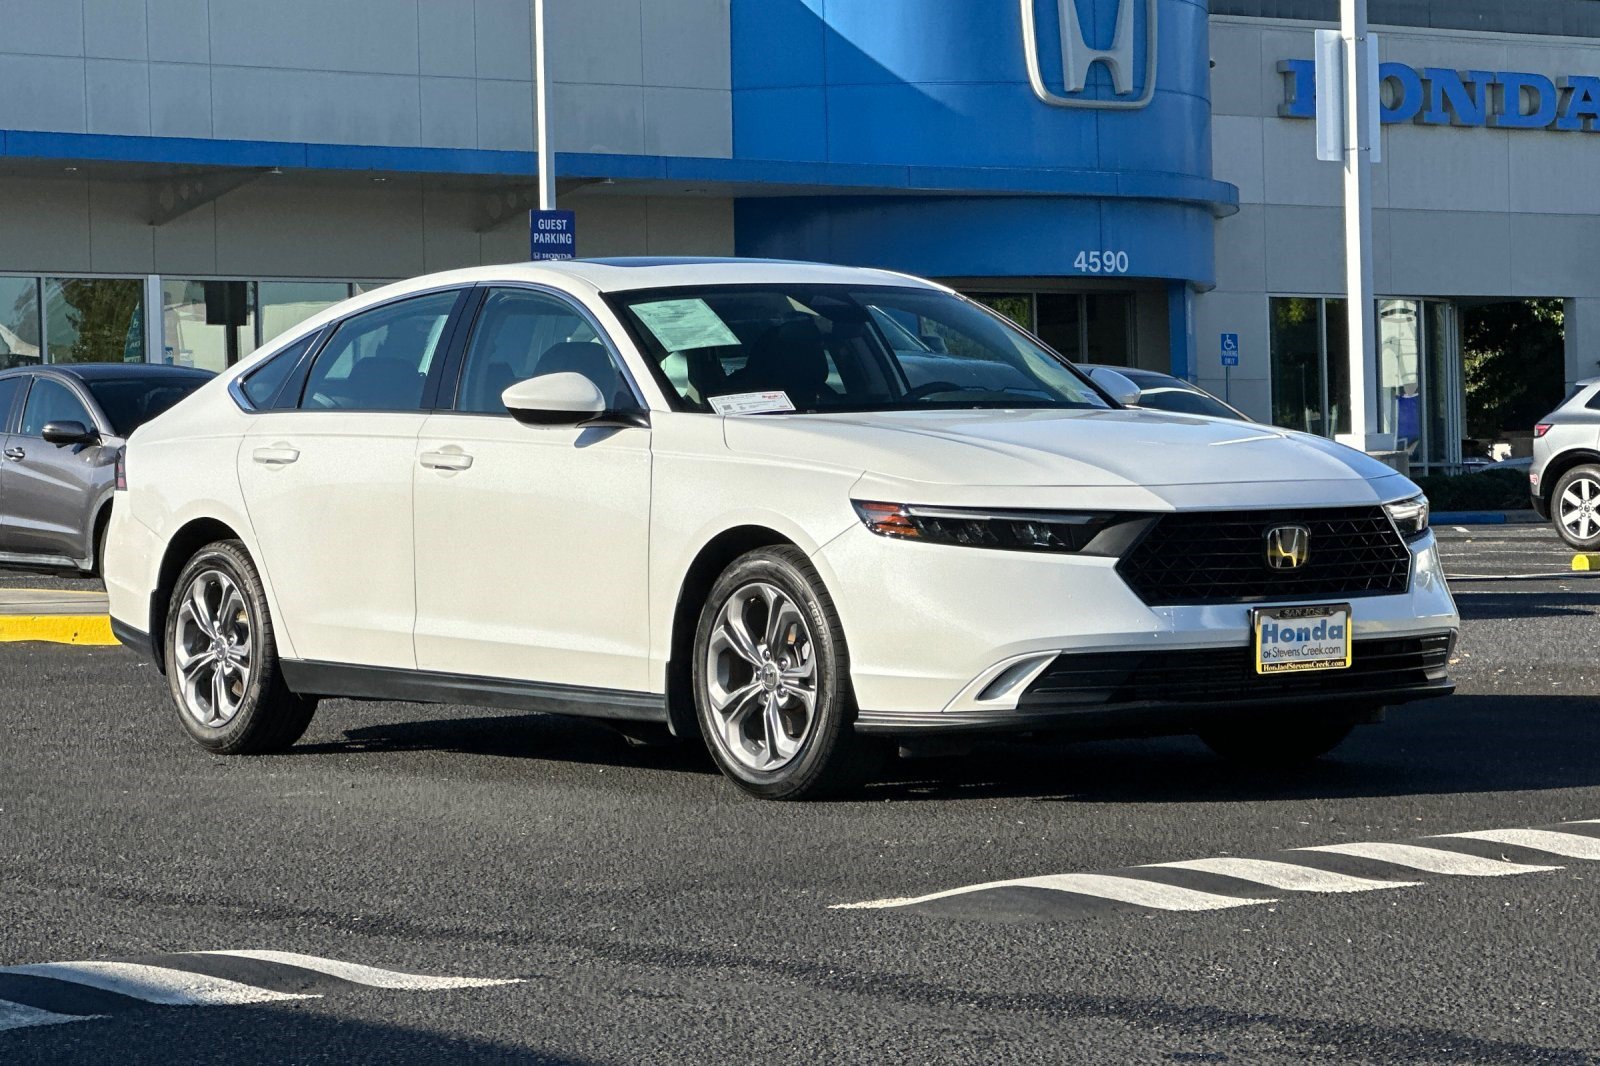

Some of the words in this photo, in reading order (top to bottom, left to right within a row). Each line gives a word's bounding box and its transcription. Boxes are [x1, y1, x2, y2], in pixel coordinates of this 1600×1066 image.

[538, 219, 567, 230] GUEST
[533, 233, 572, 244] PARKING
[542, 252, 572, 260] HONDA
[1073, 250, 1129, 273] 4590
[1261, 619, 1344, 645] Honda
[1263, 650, 1272, 659] of
[1272, 646, 1301, 658] Stevens
[1301, 642, 1342, 657] Creek.com
